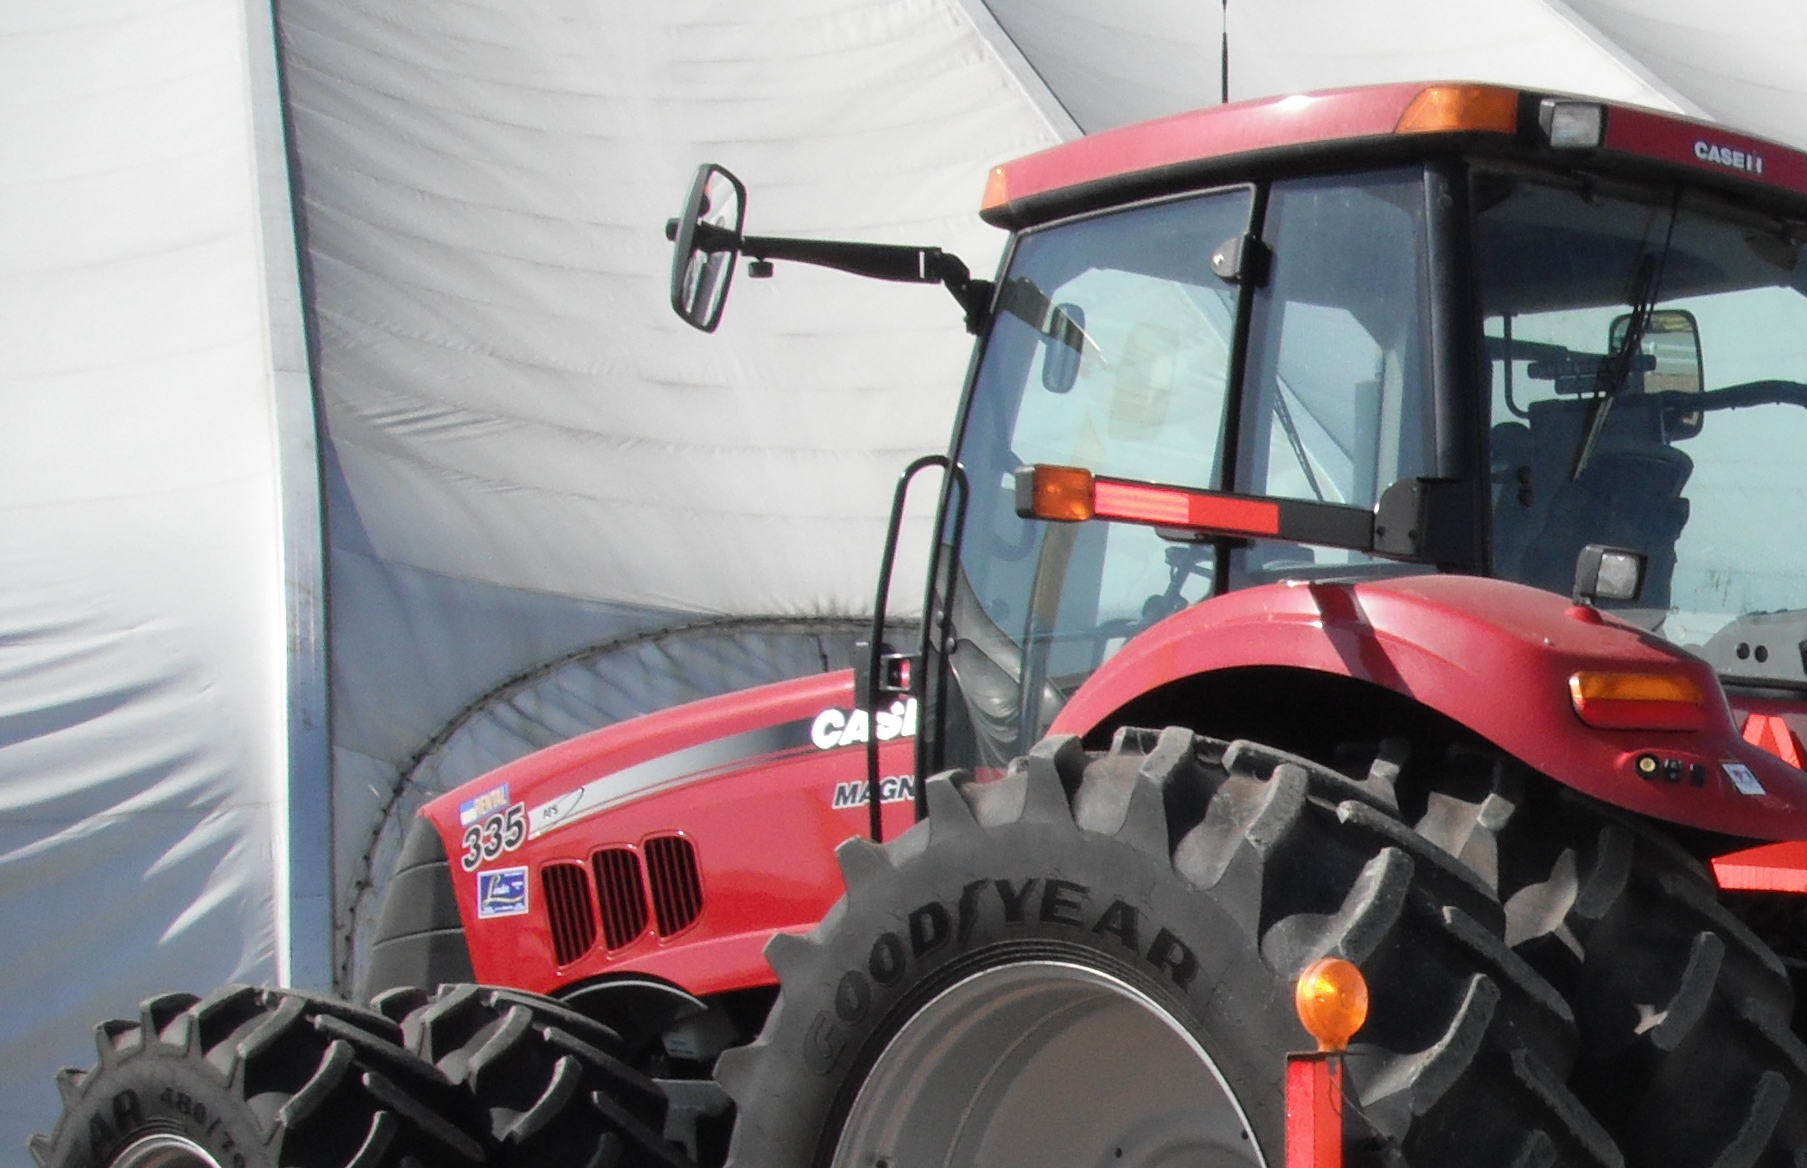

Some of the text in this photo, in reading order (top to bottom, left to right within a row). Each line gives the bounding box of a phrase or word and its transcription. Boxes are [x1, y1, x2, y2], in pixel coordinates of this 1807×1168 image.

[1693, 140, 1745, 169] CASE
[462, 801, 527, 873] 335
[803, 877, 1201, 1076] GOODYEAR
